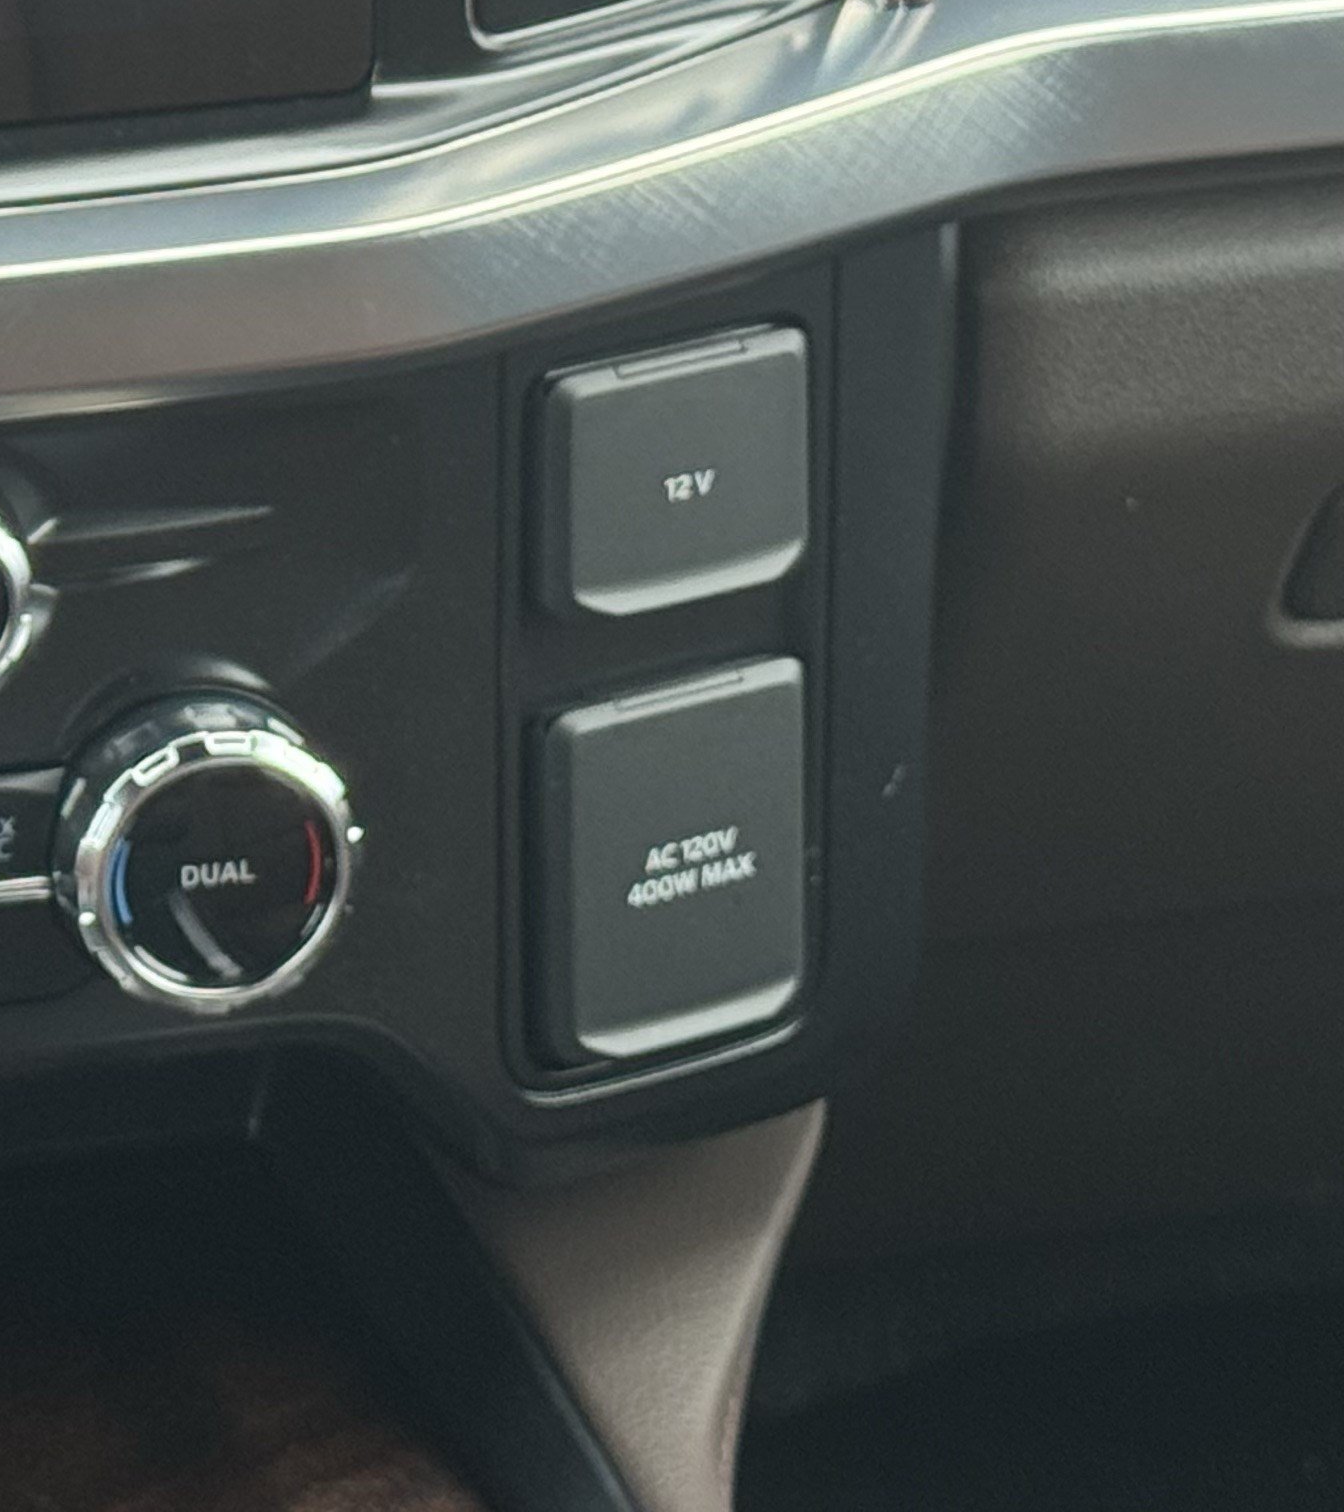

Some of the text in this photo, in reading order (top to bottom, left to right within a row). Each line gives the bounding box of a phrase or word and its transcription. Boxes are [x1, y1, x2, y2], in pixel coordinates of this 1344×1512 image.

[180, 858, 258, 890] DUAL
[644, 841, 680, 875] AC
[626, 850, 758, 909] 400W MAX
